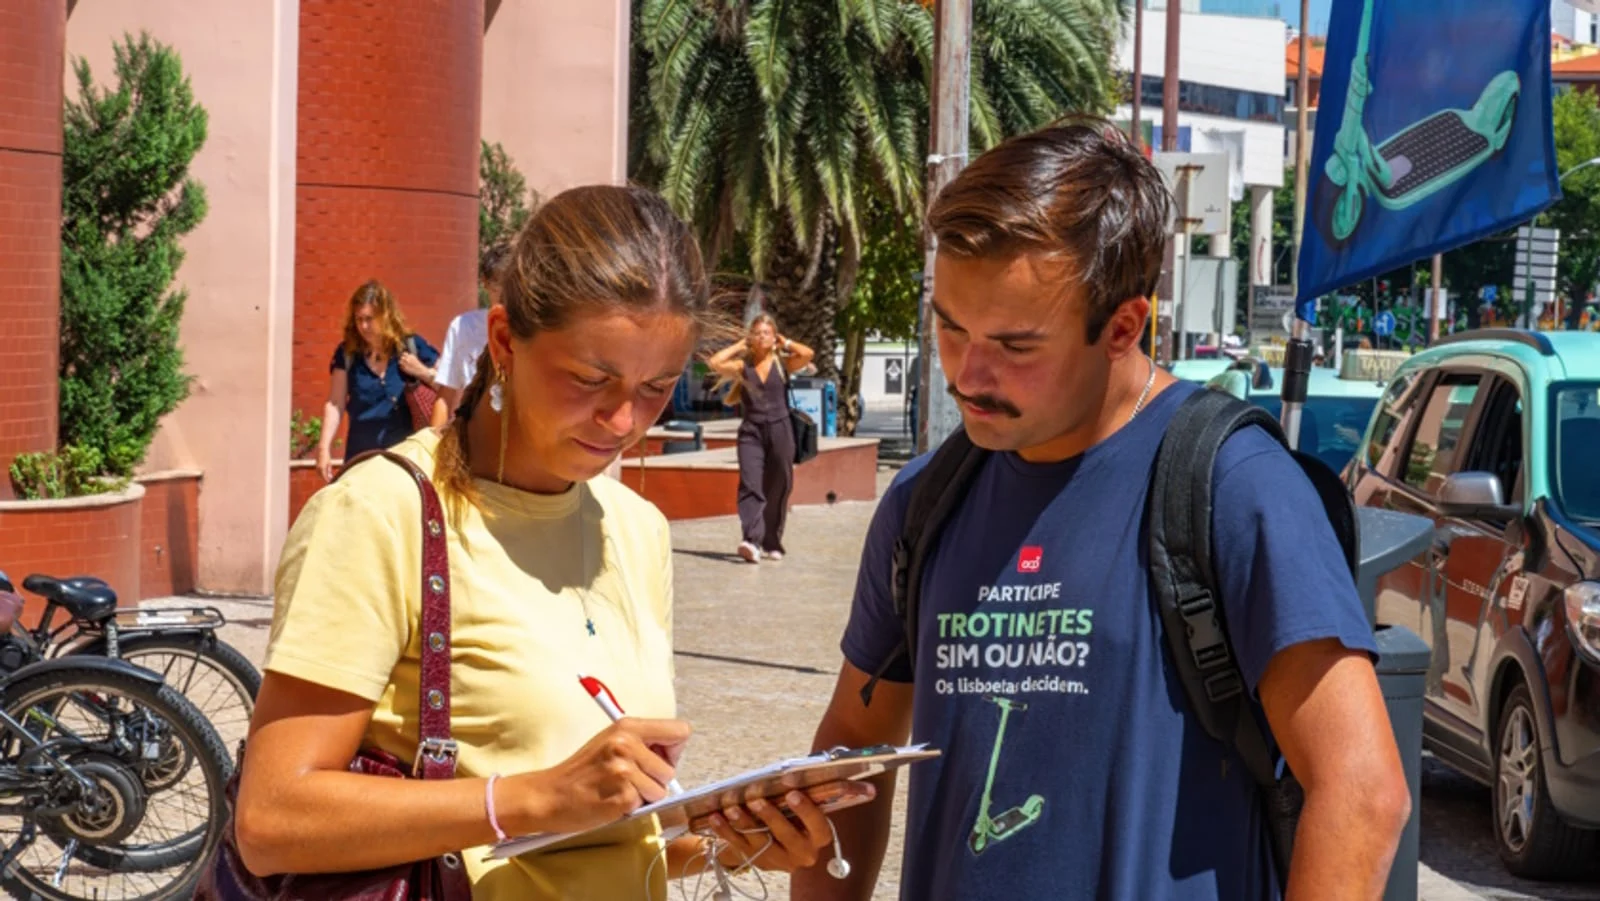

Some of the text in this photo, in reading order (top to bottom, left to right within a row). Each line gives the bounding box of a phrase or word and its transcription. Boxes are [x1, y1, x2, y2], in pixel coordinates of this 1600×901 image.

[1360, 356, 1390, 371] TAXI
[977, 582, 1062, 602] PARTICIPE
[937, 609, 1093, 638] TROTINETES
[936, 635, 1090, 669] SIM OU NÃO?
[935, 679, 954, 694] Os
[1021, 674, 1089, 694] decidem.
